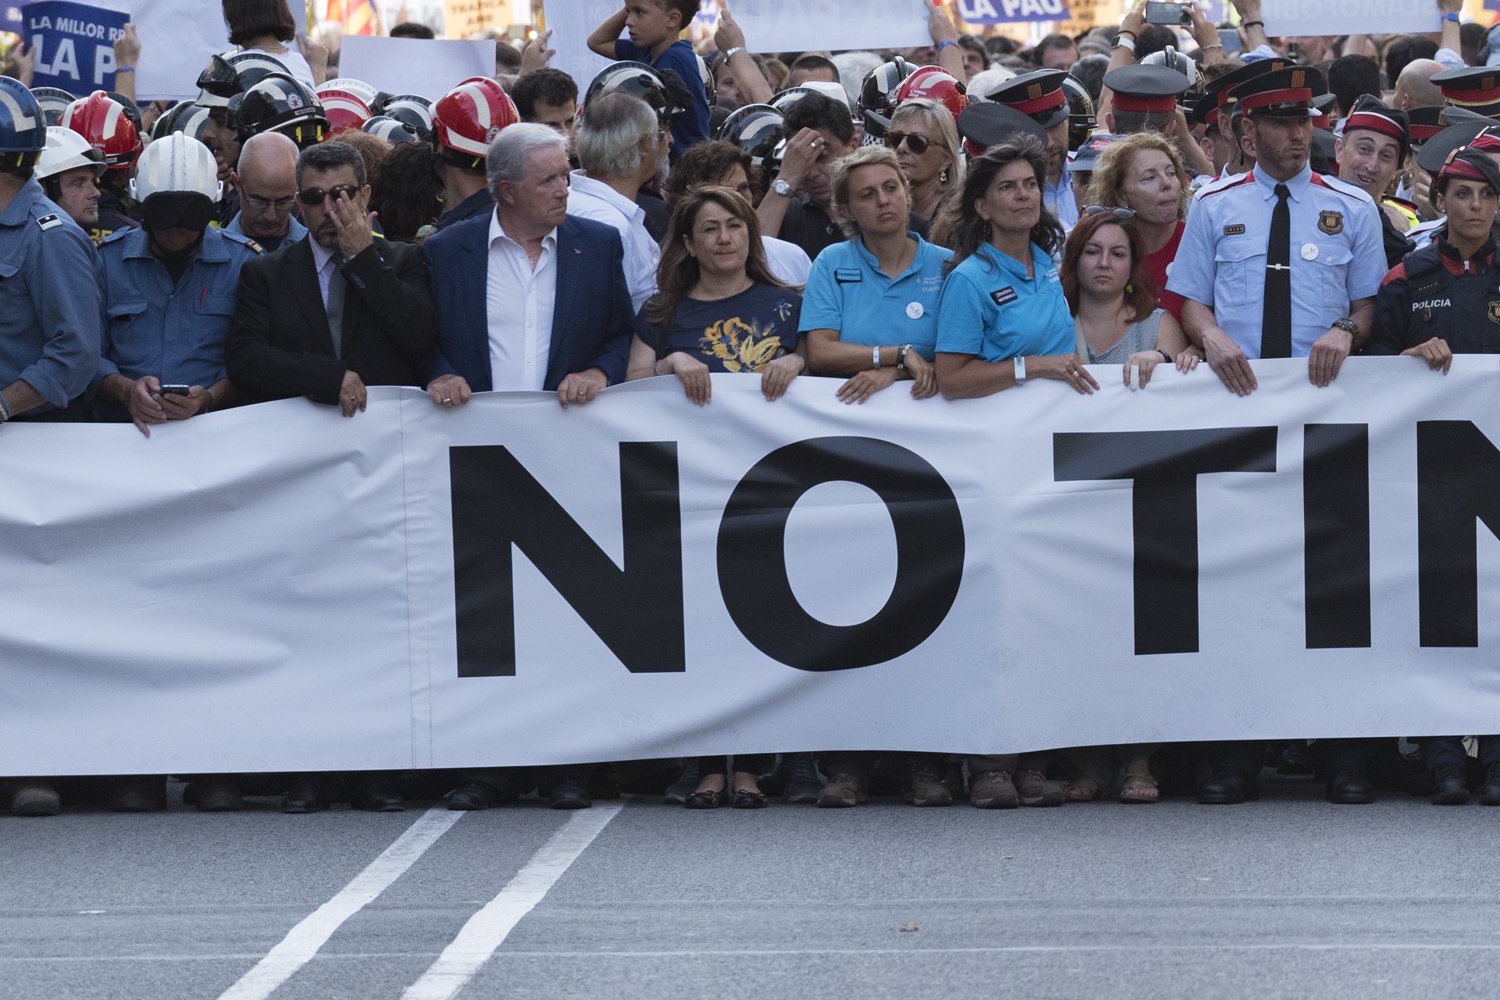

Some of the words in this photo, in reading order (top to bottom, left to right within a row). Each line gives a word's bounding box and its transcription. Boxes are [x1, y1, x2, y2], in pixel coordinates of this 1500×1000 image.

[31, 16, 52, 30] LA
[56, 17, 105, 40] MILLOR
[32, 33, 80, 81] LA
[1412, 299, 1451, 312] POLICIA
[449, 435, 967, 678] NO
